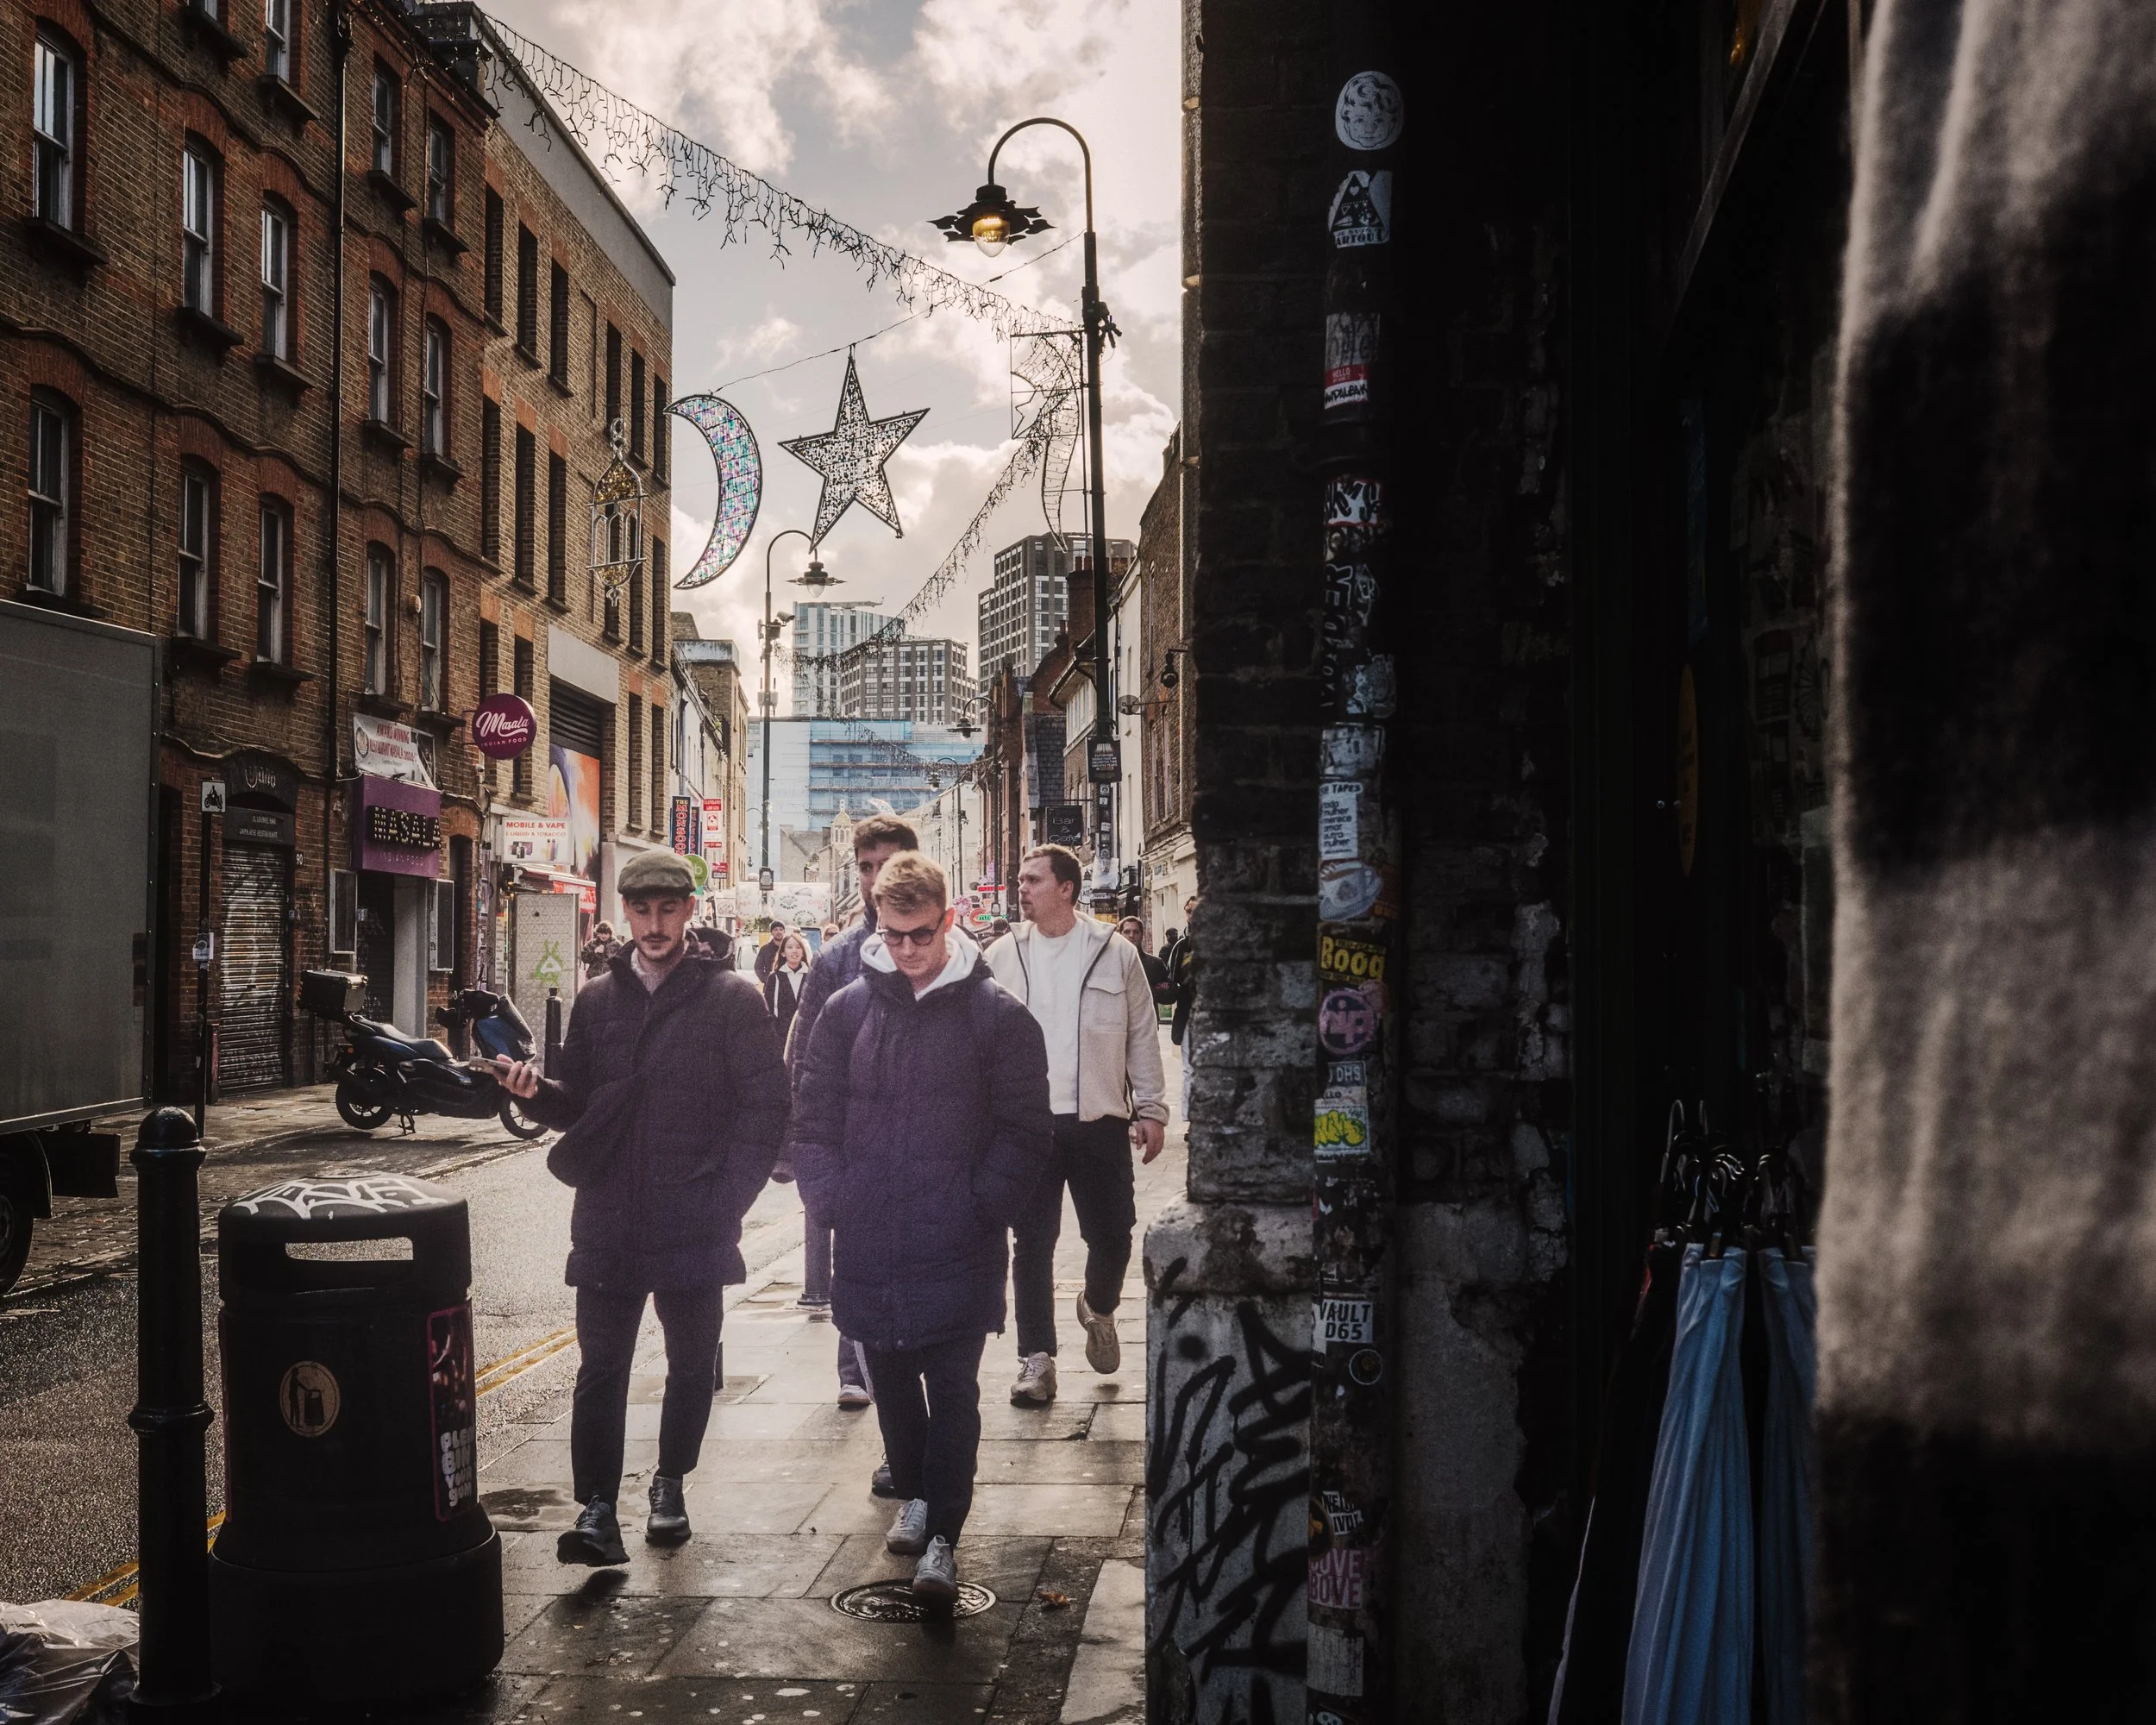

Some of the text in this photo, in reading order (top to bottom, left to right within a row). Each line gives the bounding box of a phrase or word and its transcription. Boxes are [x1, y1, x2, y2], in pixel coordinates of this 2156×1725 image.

[1332, 367, 1351, 379] HELLO
[475, 711, 530, 737] Masala
[376, 724, 410, 744] AWARD WINNING
[480, 737, 528, 748] INDIAN FOOD
[390, 743, 404, 760] MASALA
[1332, 784, 1361, 794] TAPES
[369, 806, 442, 850] MASALA
[1052, 817, 1078, 825] Bar
[239, 827, 278, 838] JAPANESE RESTAURANT
[296, 853, 304, 866] 90
[1336, 1066, 1361, 1082] DHS
[1319, 1302, 1371, 1323] VAULT
[1326, 1321, 1363, 1340] D65
